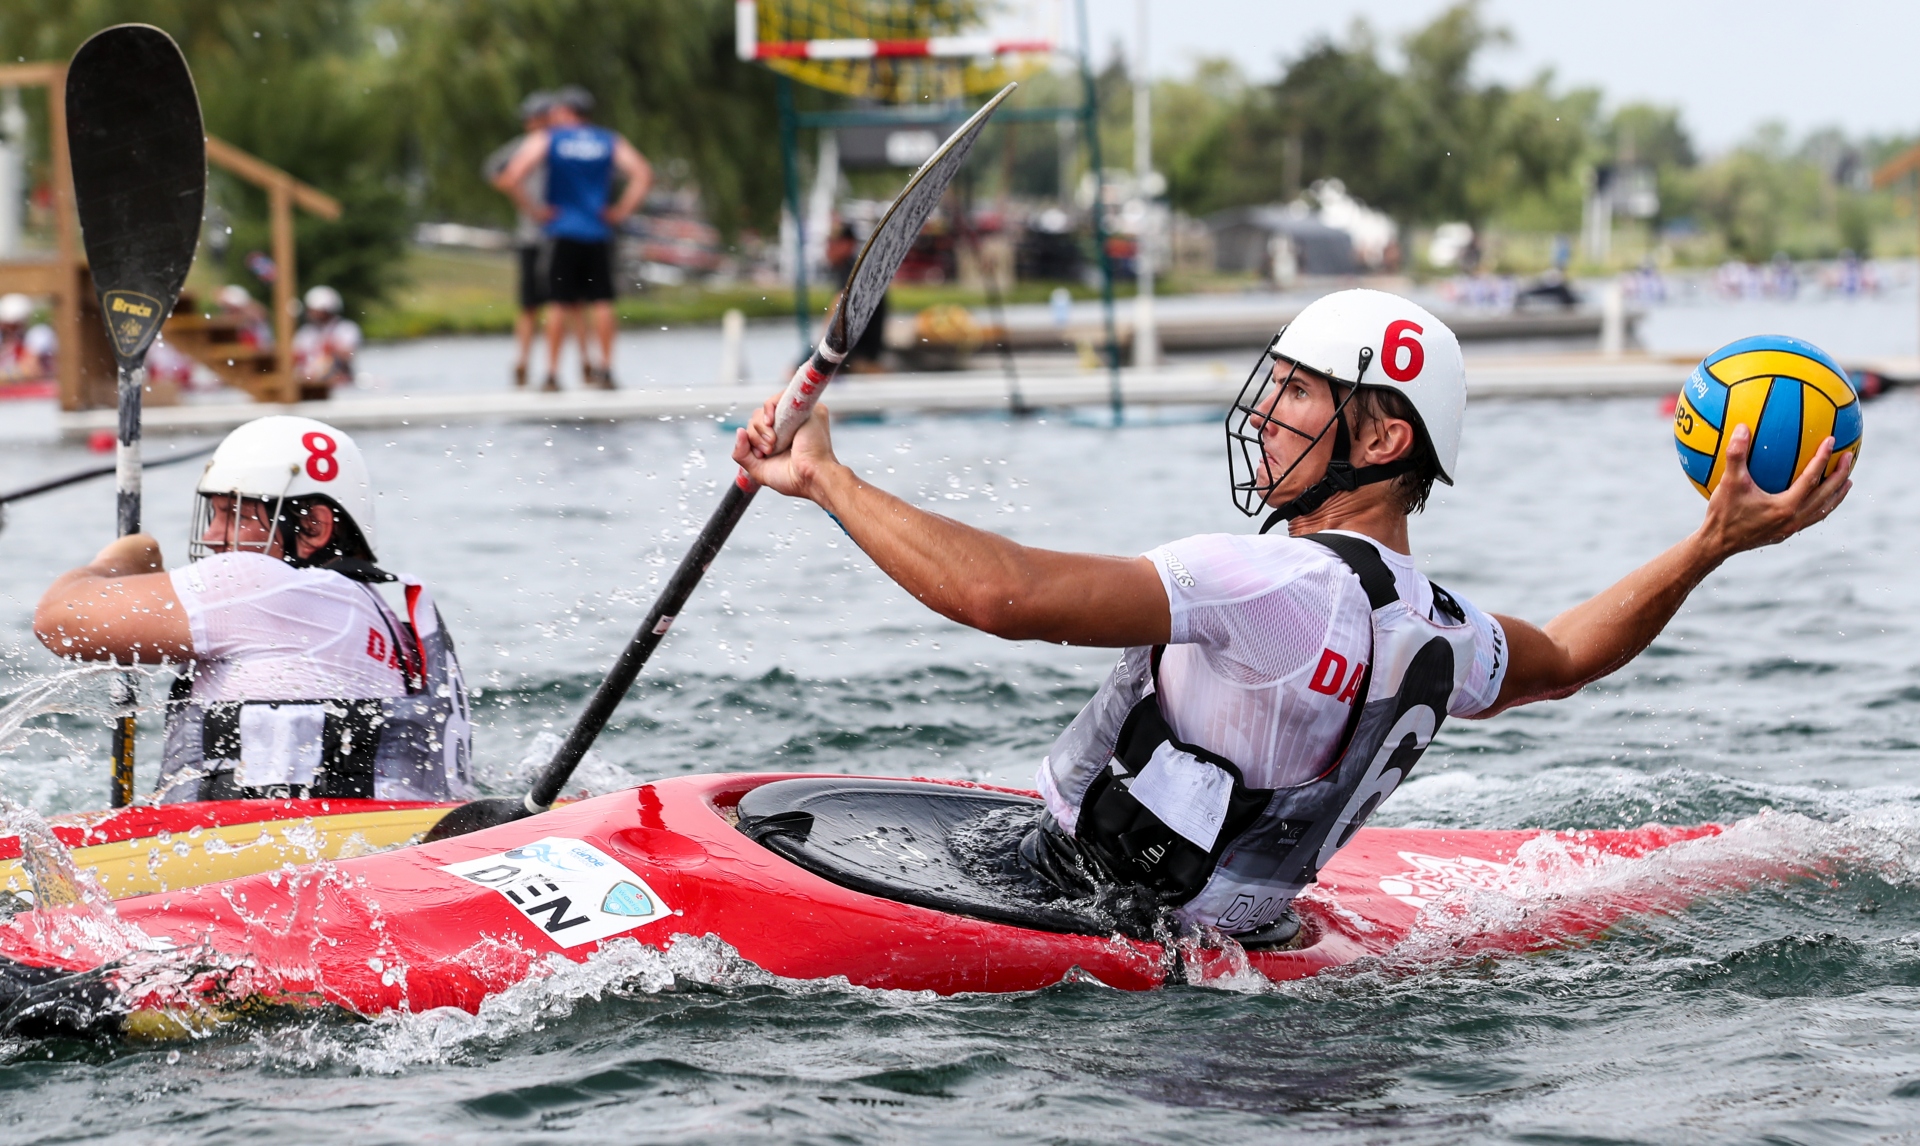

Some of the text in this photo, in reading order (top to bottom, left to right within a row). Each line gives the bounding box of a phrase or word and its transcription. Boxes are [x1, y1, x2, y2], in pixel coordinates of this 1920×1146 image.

[1381, 319, 1425, 382] 6
[302, 432, 339, 482] 8
[1315, 703, 1437, 872] 6
[462, 864, 591, 934] DEN
